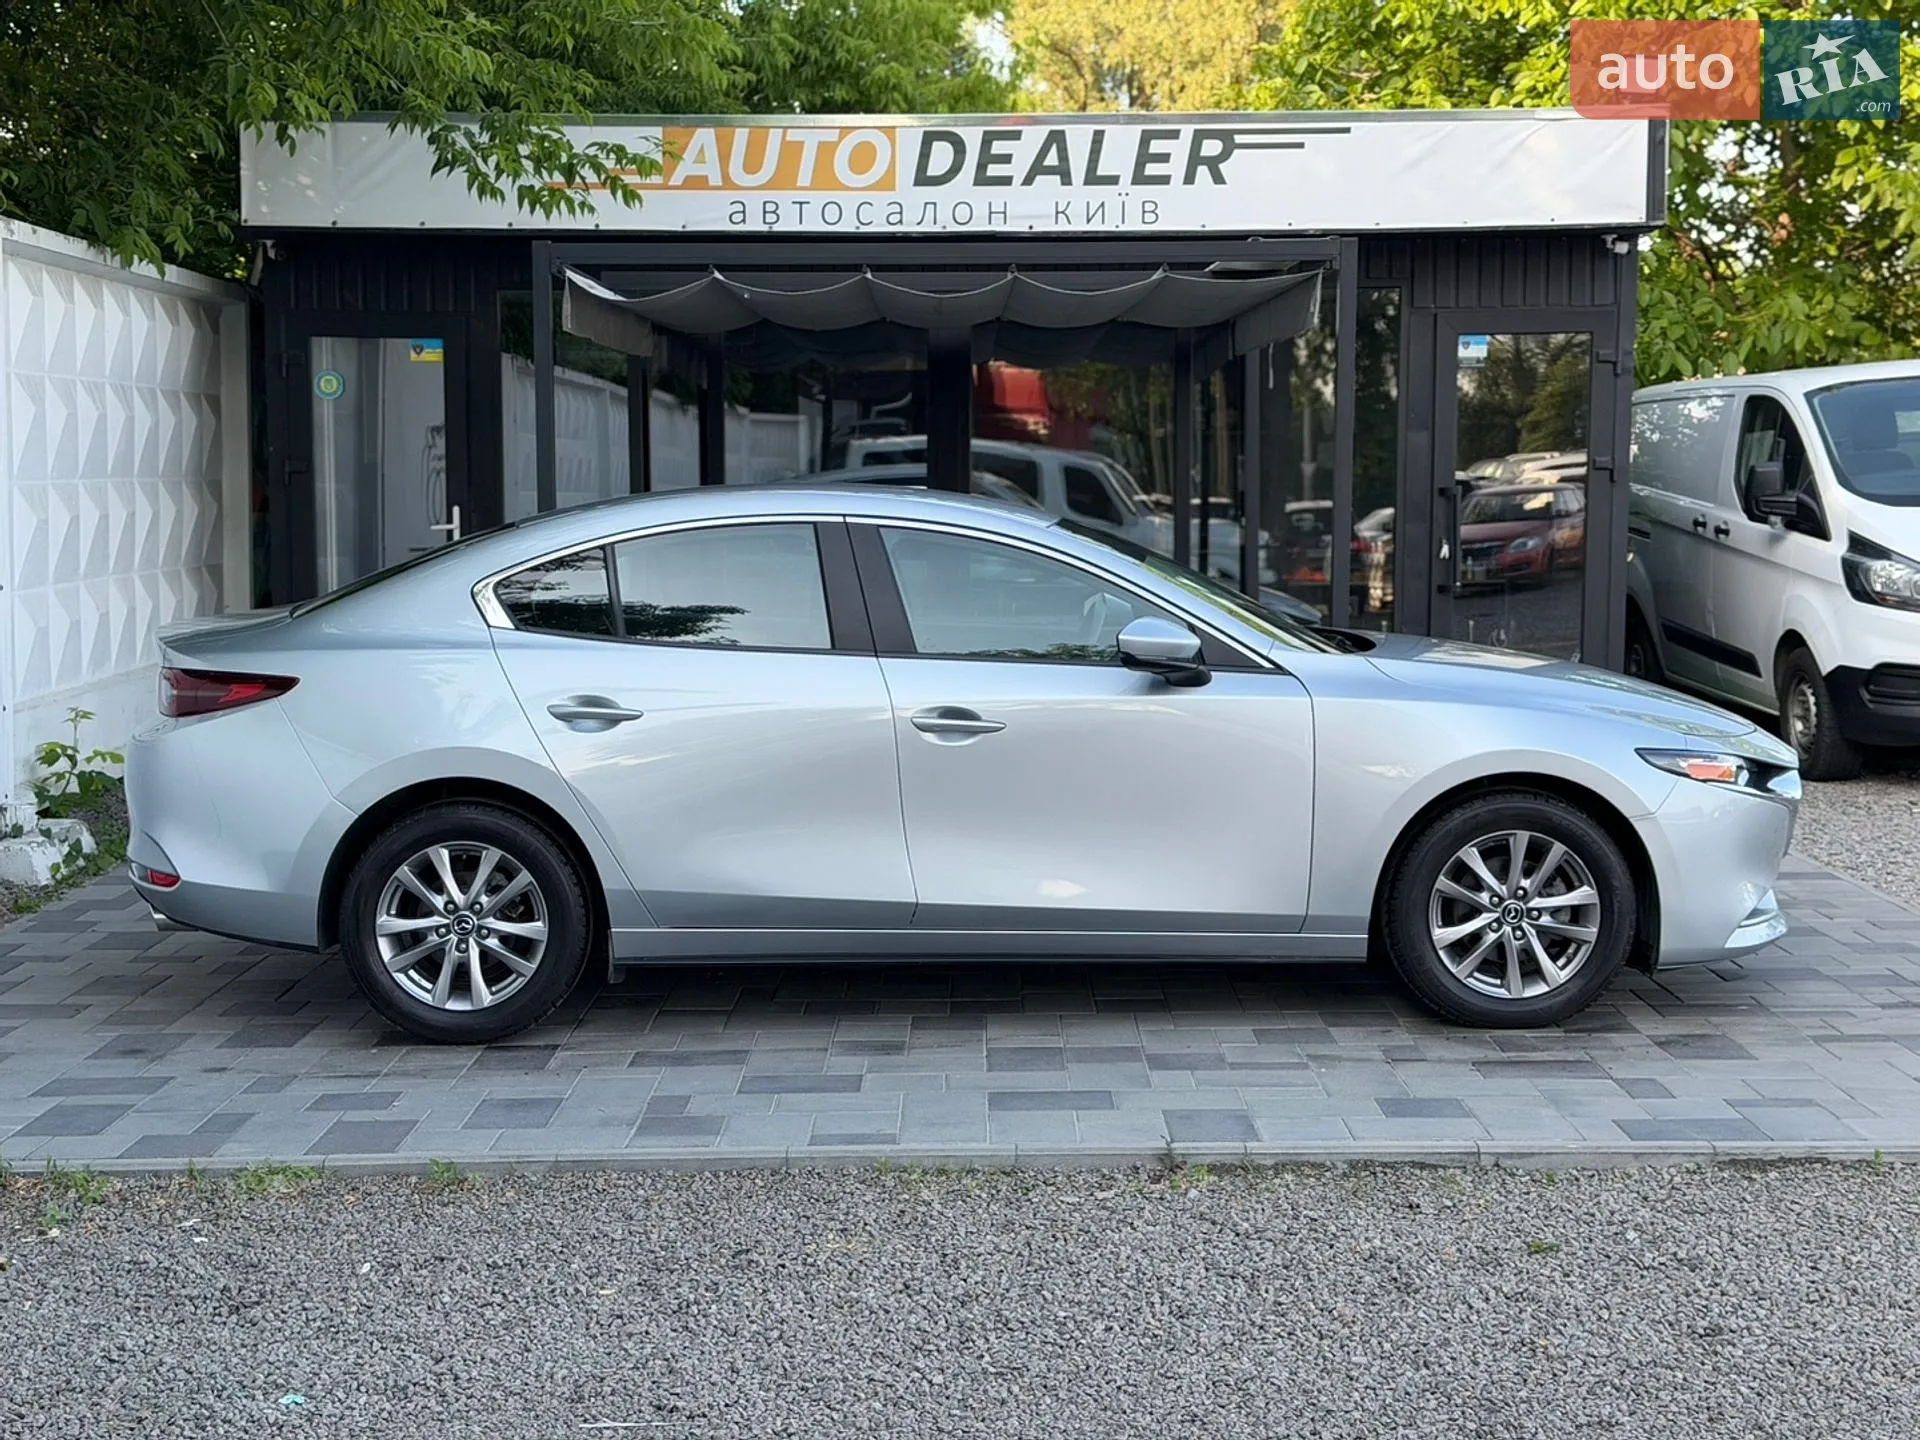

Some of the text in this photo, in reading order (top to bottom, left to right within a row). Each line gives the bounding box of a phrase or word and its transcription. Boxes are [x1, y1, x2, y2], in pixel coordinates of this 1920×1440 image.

[668, 127, 1236, 188] AUTO DEALER
[728, 193, 1160, 226] автосалон київ
